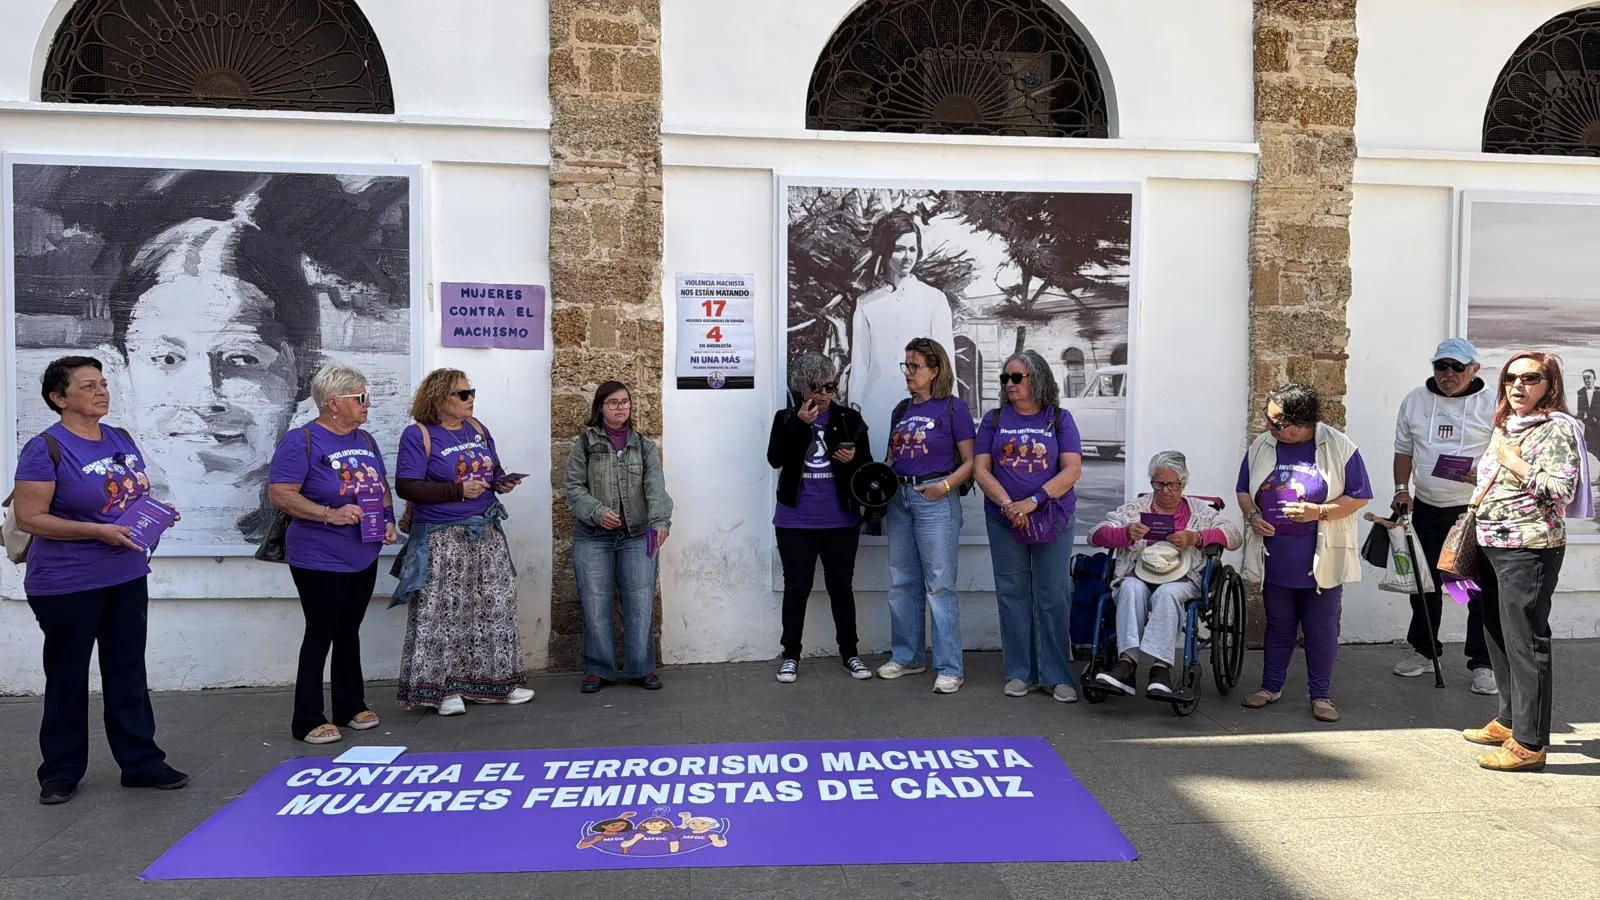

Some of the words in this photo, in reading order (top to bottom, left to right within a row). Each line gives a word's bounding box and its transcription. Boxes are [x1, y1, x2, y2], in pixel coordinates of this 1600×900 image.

[461, 288, 522, 300] MUJERES
[695, 288, 715, 296] ESTÁN
[716, 289, 750, 297] MATANDO
[449, 306, 505, 317] CONTRA
[516, 307, 534, 318] EL
[702, 300, 727, 317] 17
[453, 327, 529, 338] MACHISMO
[706, 326, 723, 342] 4
[690, 356, 700, 364] NI
[701, 356, 720, 364] UNA
[721, 354, 741, 364] MÁS
[286, 764, 462, 787] CONTRA
[474, 762, 525, 783] EL
[543, 753, 809, 780] TERRORISMO
[821, 749, 1034, 772] MACHISTA
[276, 788, 513, 815] MUJERES
[521, 780, 804, 809] FEMINISTAS
[817, 779, 879, 801] DE
[890, 771, 1035, 800] CÁDIZ
